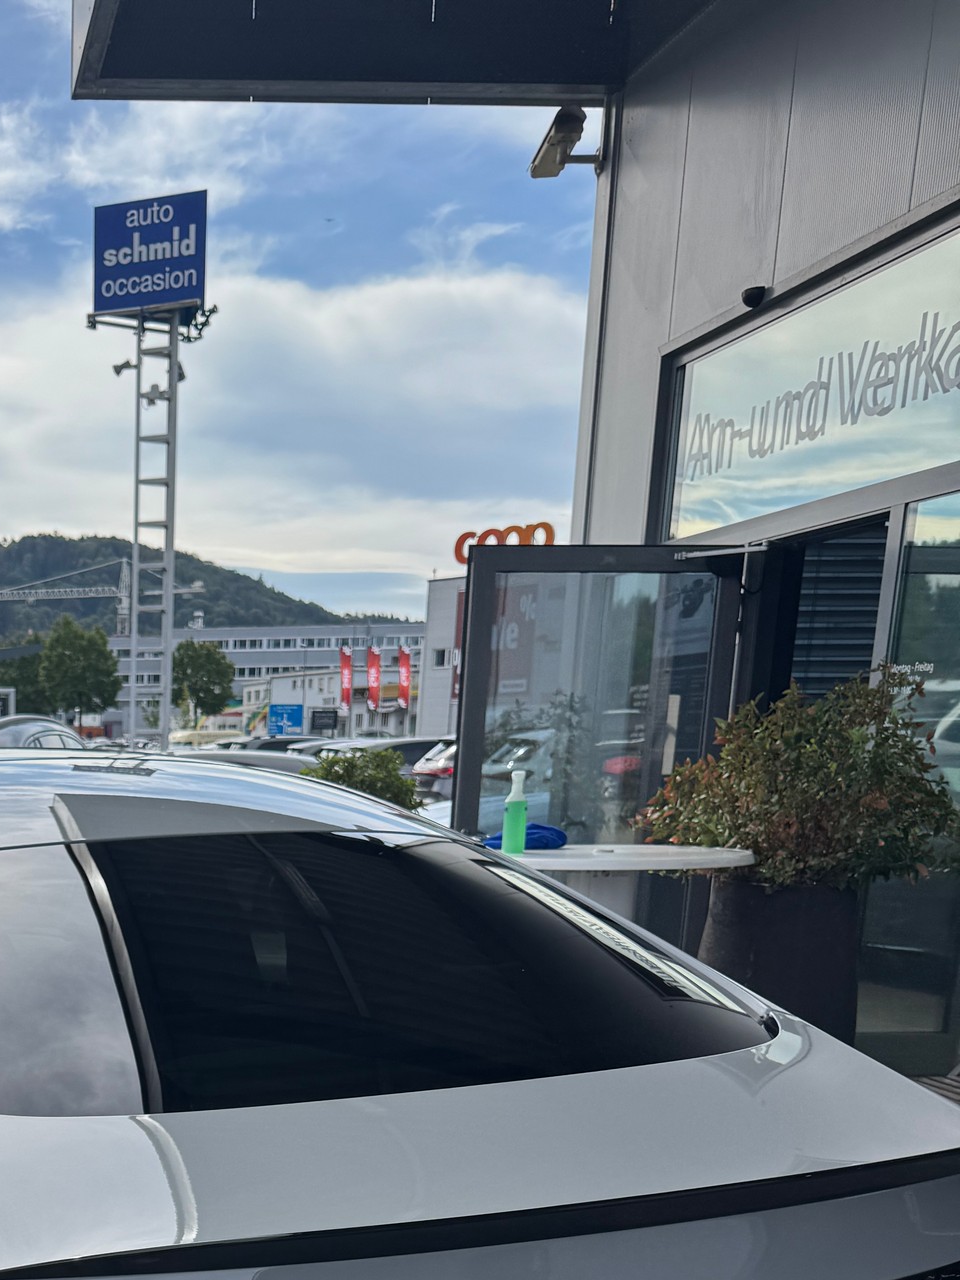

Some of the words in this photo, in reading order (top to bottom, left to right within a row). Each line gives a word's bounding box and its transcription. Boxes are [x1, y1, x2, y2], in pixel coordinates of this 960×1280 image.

[126, 202, 174, 228] auto
[103, 224, 196, 267] schmid
[101, 267, 197, 297] occasion
